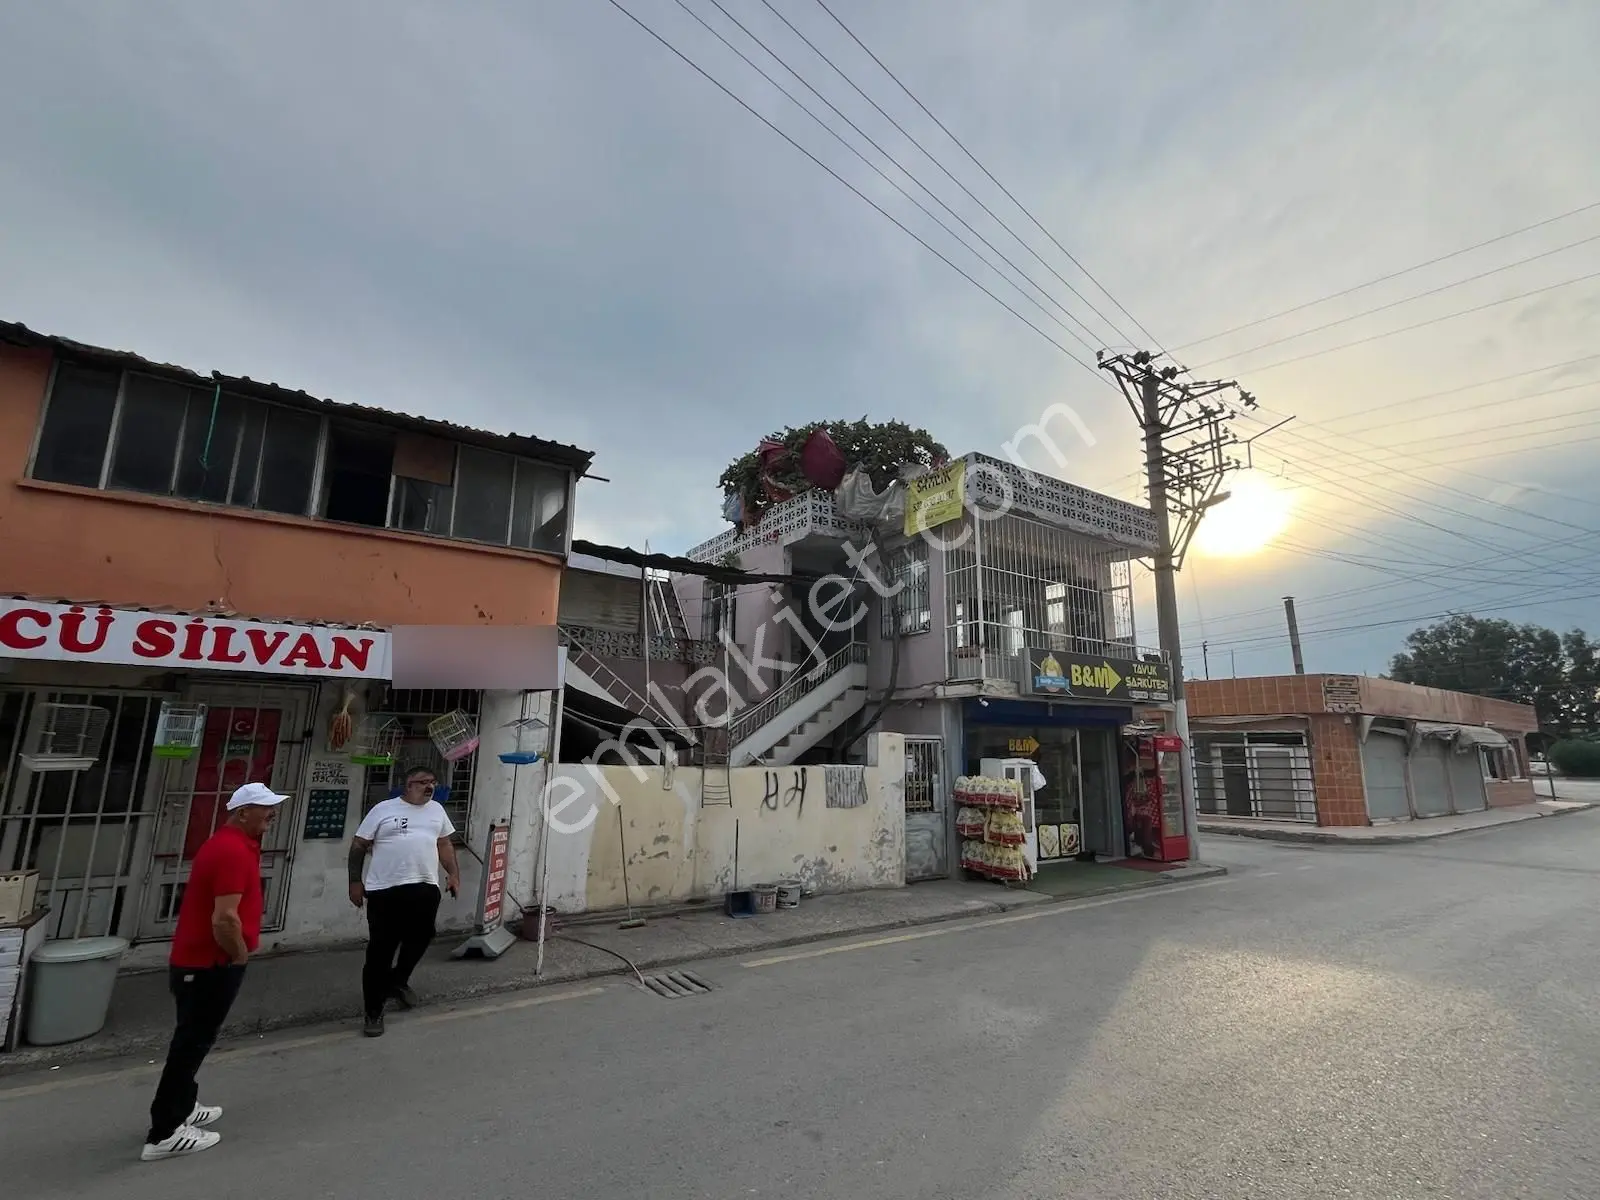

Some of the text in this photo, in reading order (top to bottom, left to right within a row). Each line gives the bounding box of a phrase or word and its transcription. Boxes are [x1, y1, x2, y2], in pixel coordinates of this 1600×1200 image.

[132, 617, 374, 672] SİLVAN
[1071, 663, 1110, 688] B&M
[1132, 663, 1157, 676] TAVUK
